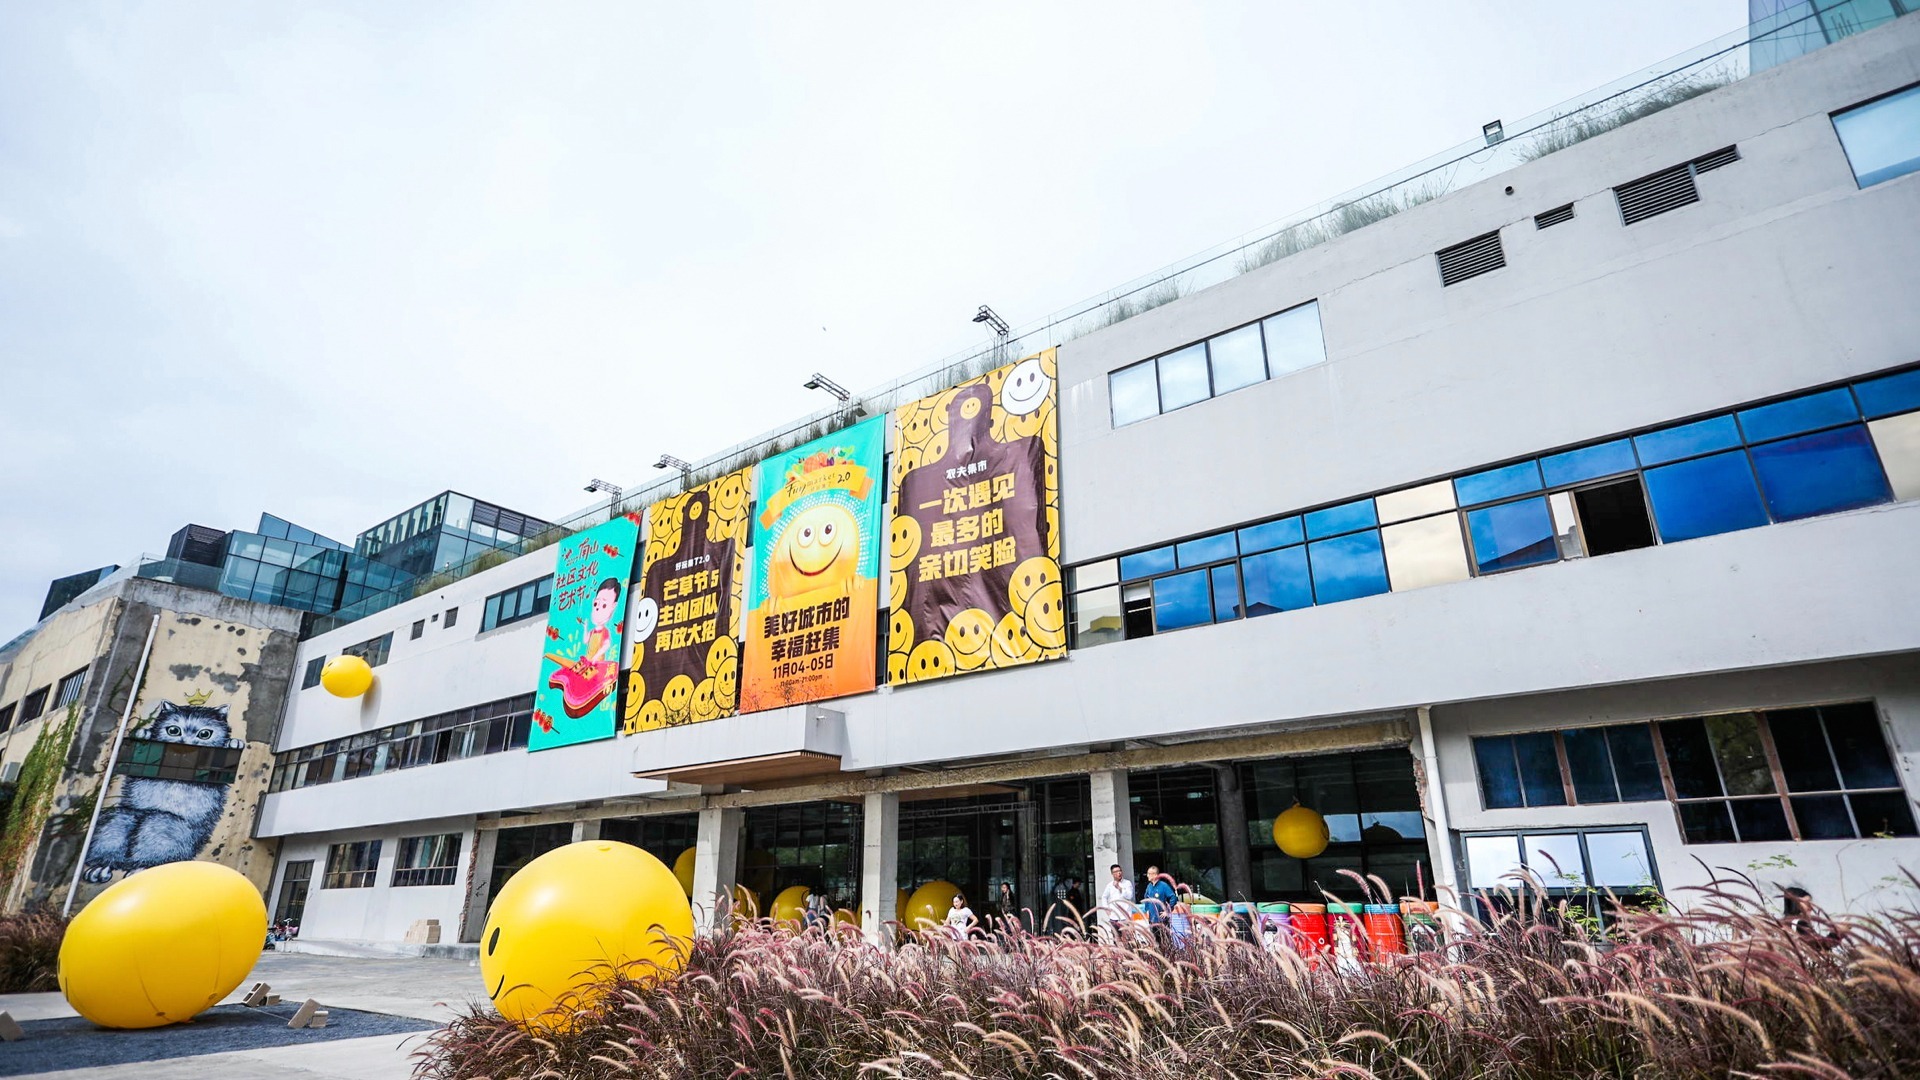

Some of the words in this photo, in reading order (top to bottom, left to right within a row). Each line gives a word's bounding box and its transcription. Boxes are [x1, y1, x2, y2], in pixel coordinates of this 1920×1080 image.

[837, 472, 851, 484] 2.0
[946, 460, 987, 480] 农夫集市
[919, 472, 1015, 514] 一次遇见
[931, 508, 1003, 547] 最多的
[556, 560, 599, 590] 社区文化
[919, 536, 1016, 582] 亲切笑脸
[663, 569, 719, 601] 芒草节5
[657, 592, 718, 627] 主创团队
[764, 596, 850, 639] 美好城市的
[655, 618, 717, 653] 再放大招
[771, 626, 840, 662] 幸福赶集
[773, 653, 834, 679] 11月04-05日
